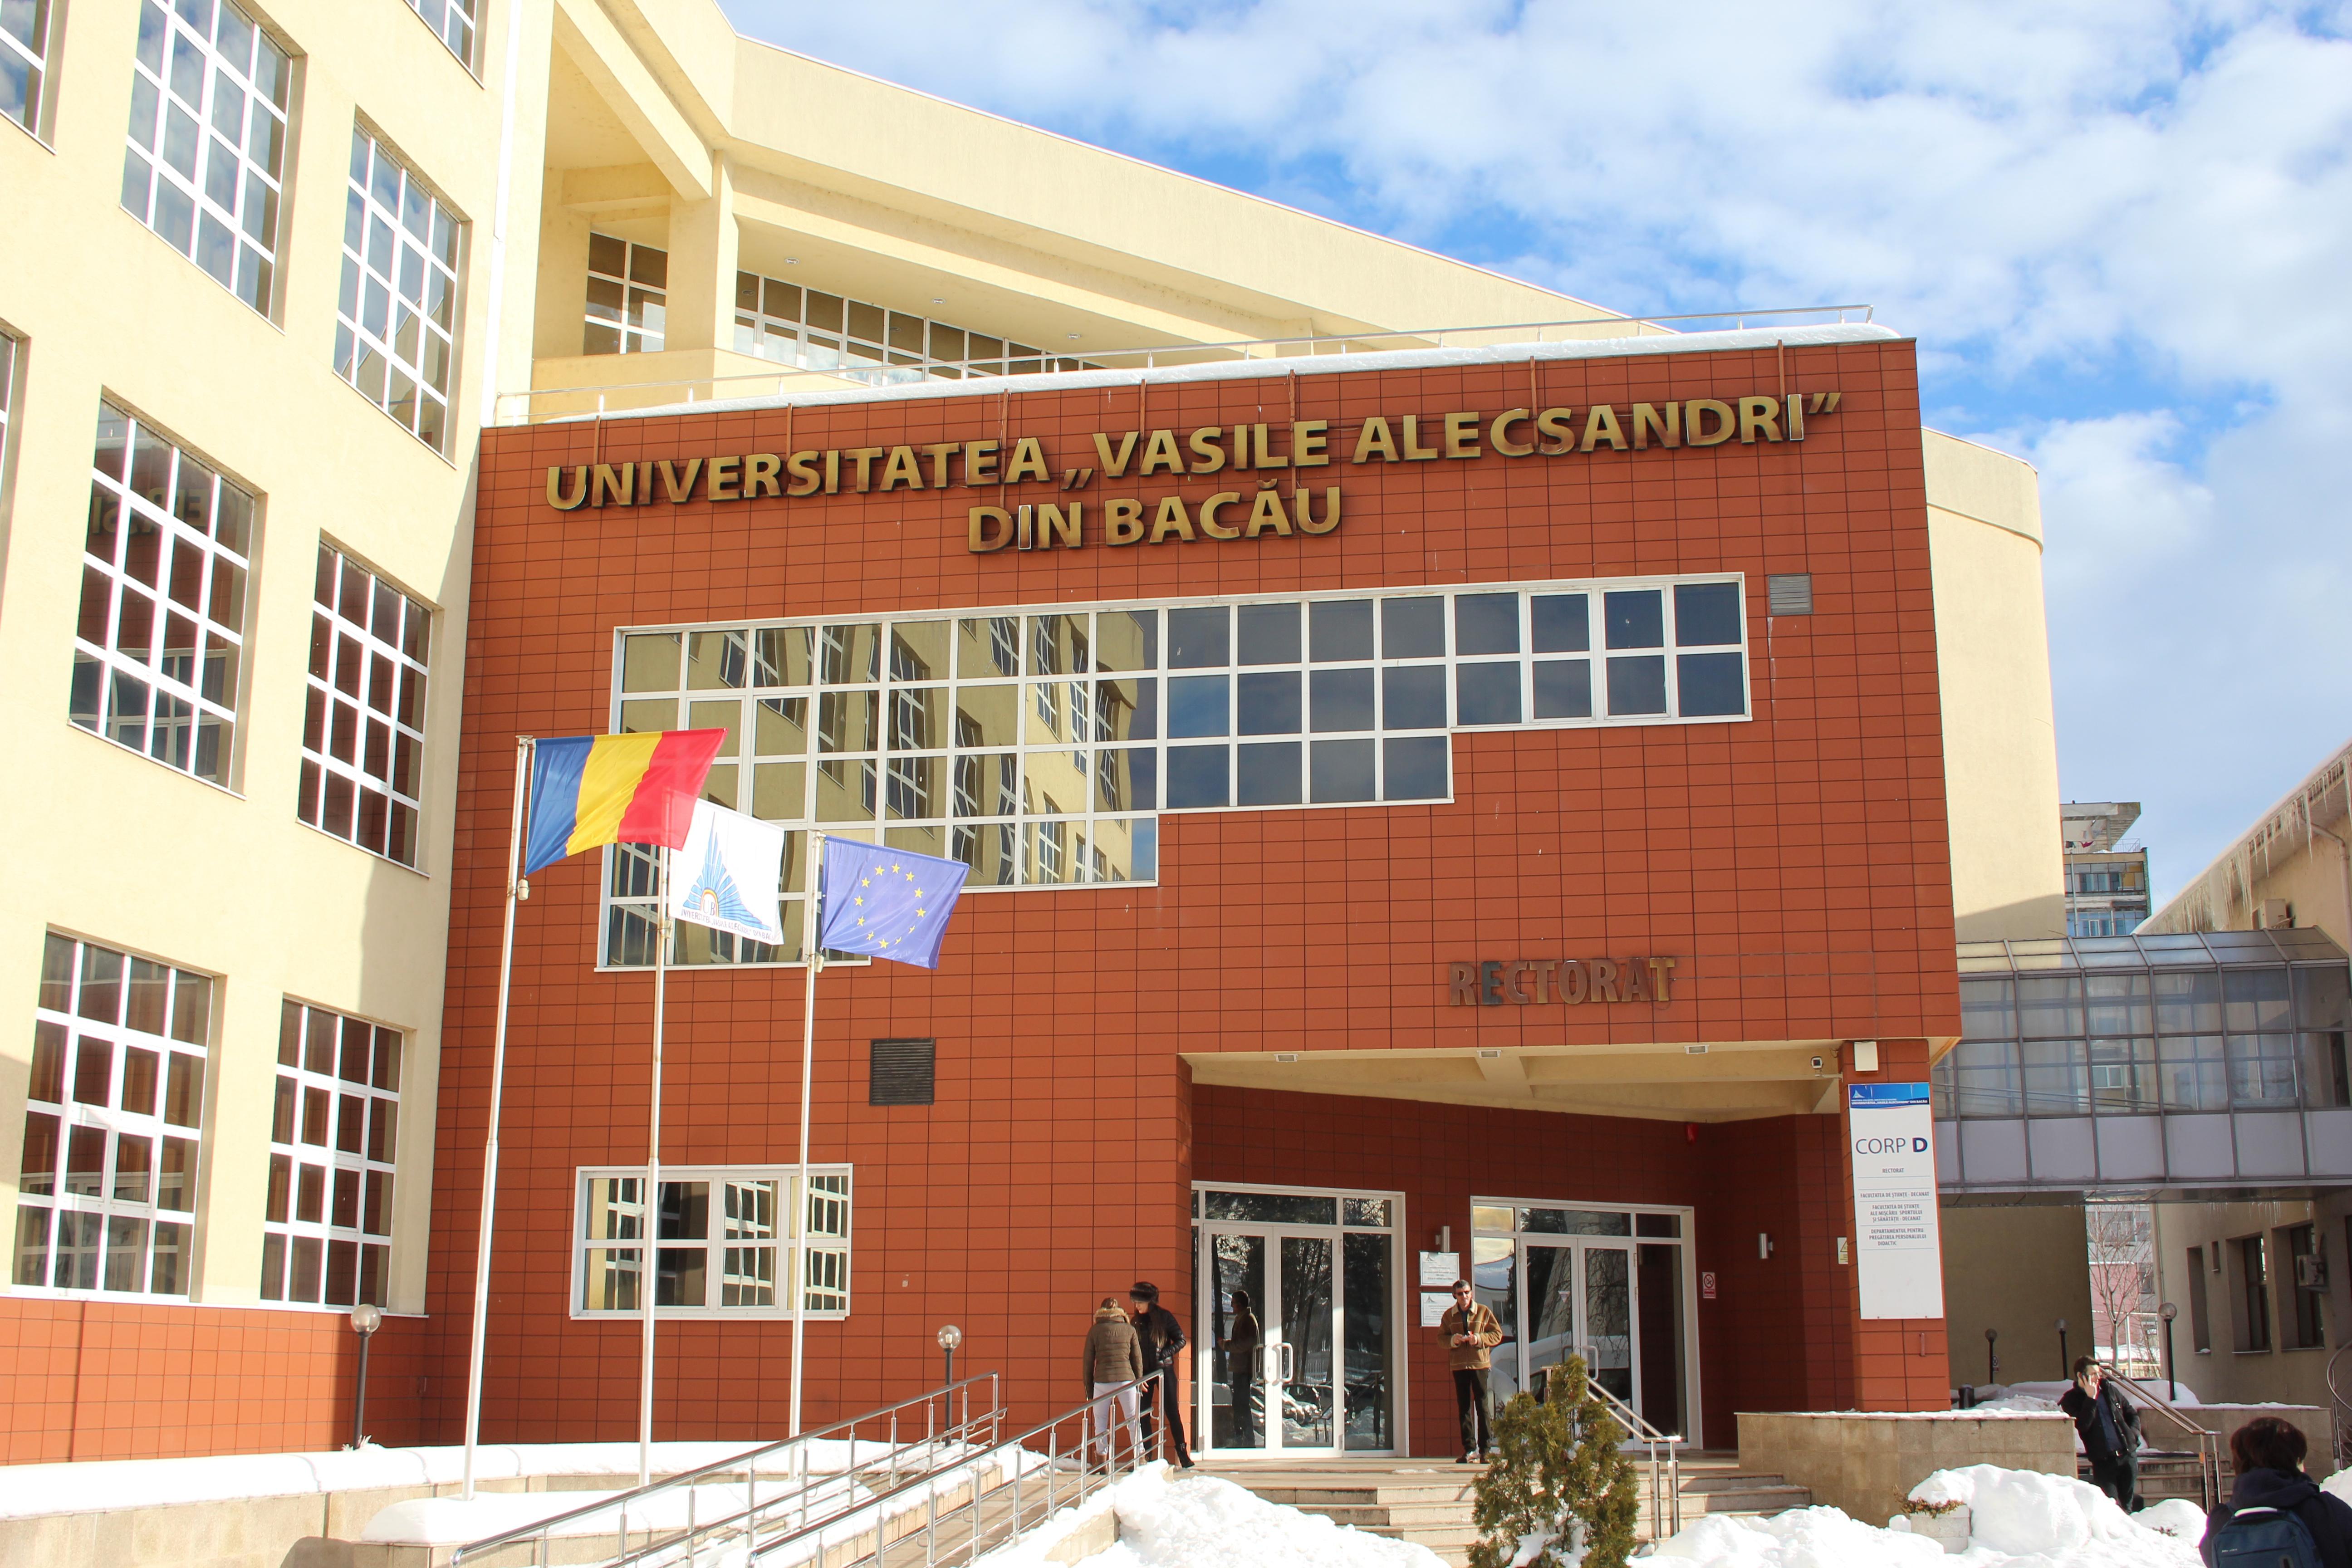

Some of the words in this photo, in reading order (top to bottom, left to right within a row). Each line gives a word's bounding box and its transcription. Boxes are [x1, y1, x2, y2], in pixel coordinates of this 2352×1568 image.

[546, 437, 1051, 510] UNIVERSITATEA
[1060, 419, 1330, 491] „VASILE
[968, 501, 1082, 553] DIN
[1105, 477, 1341, 545] BACĂU
[702, 900, 716, 916] UB
[1449, 956, 1676, 1006] RECTORAT
[1856, 1138, 1906, 1154] CORP
[1912, 1137, 1928, 1152] D
